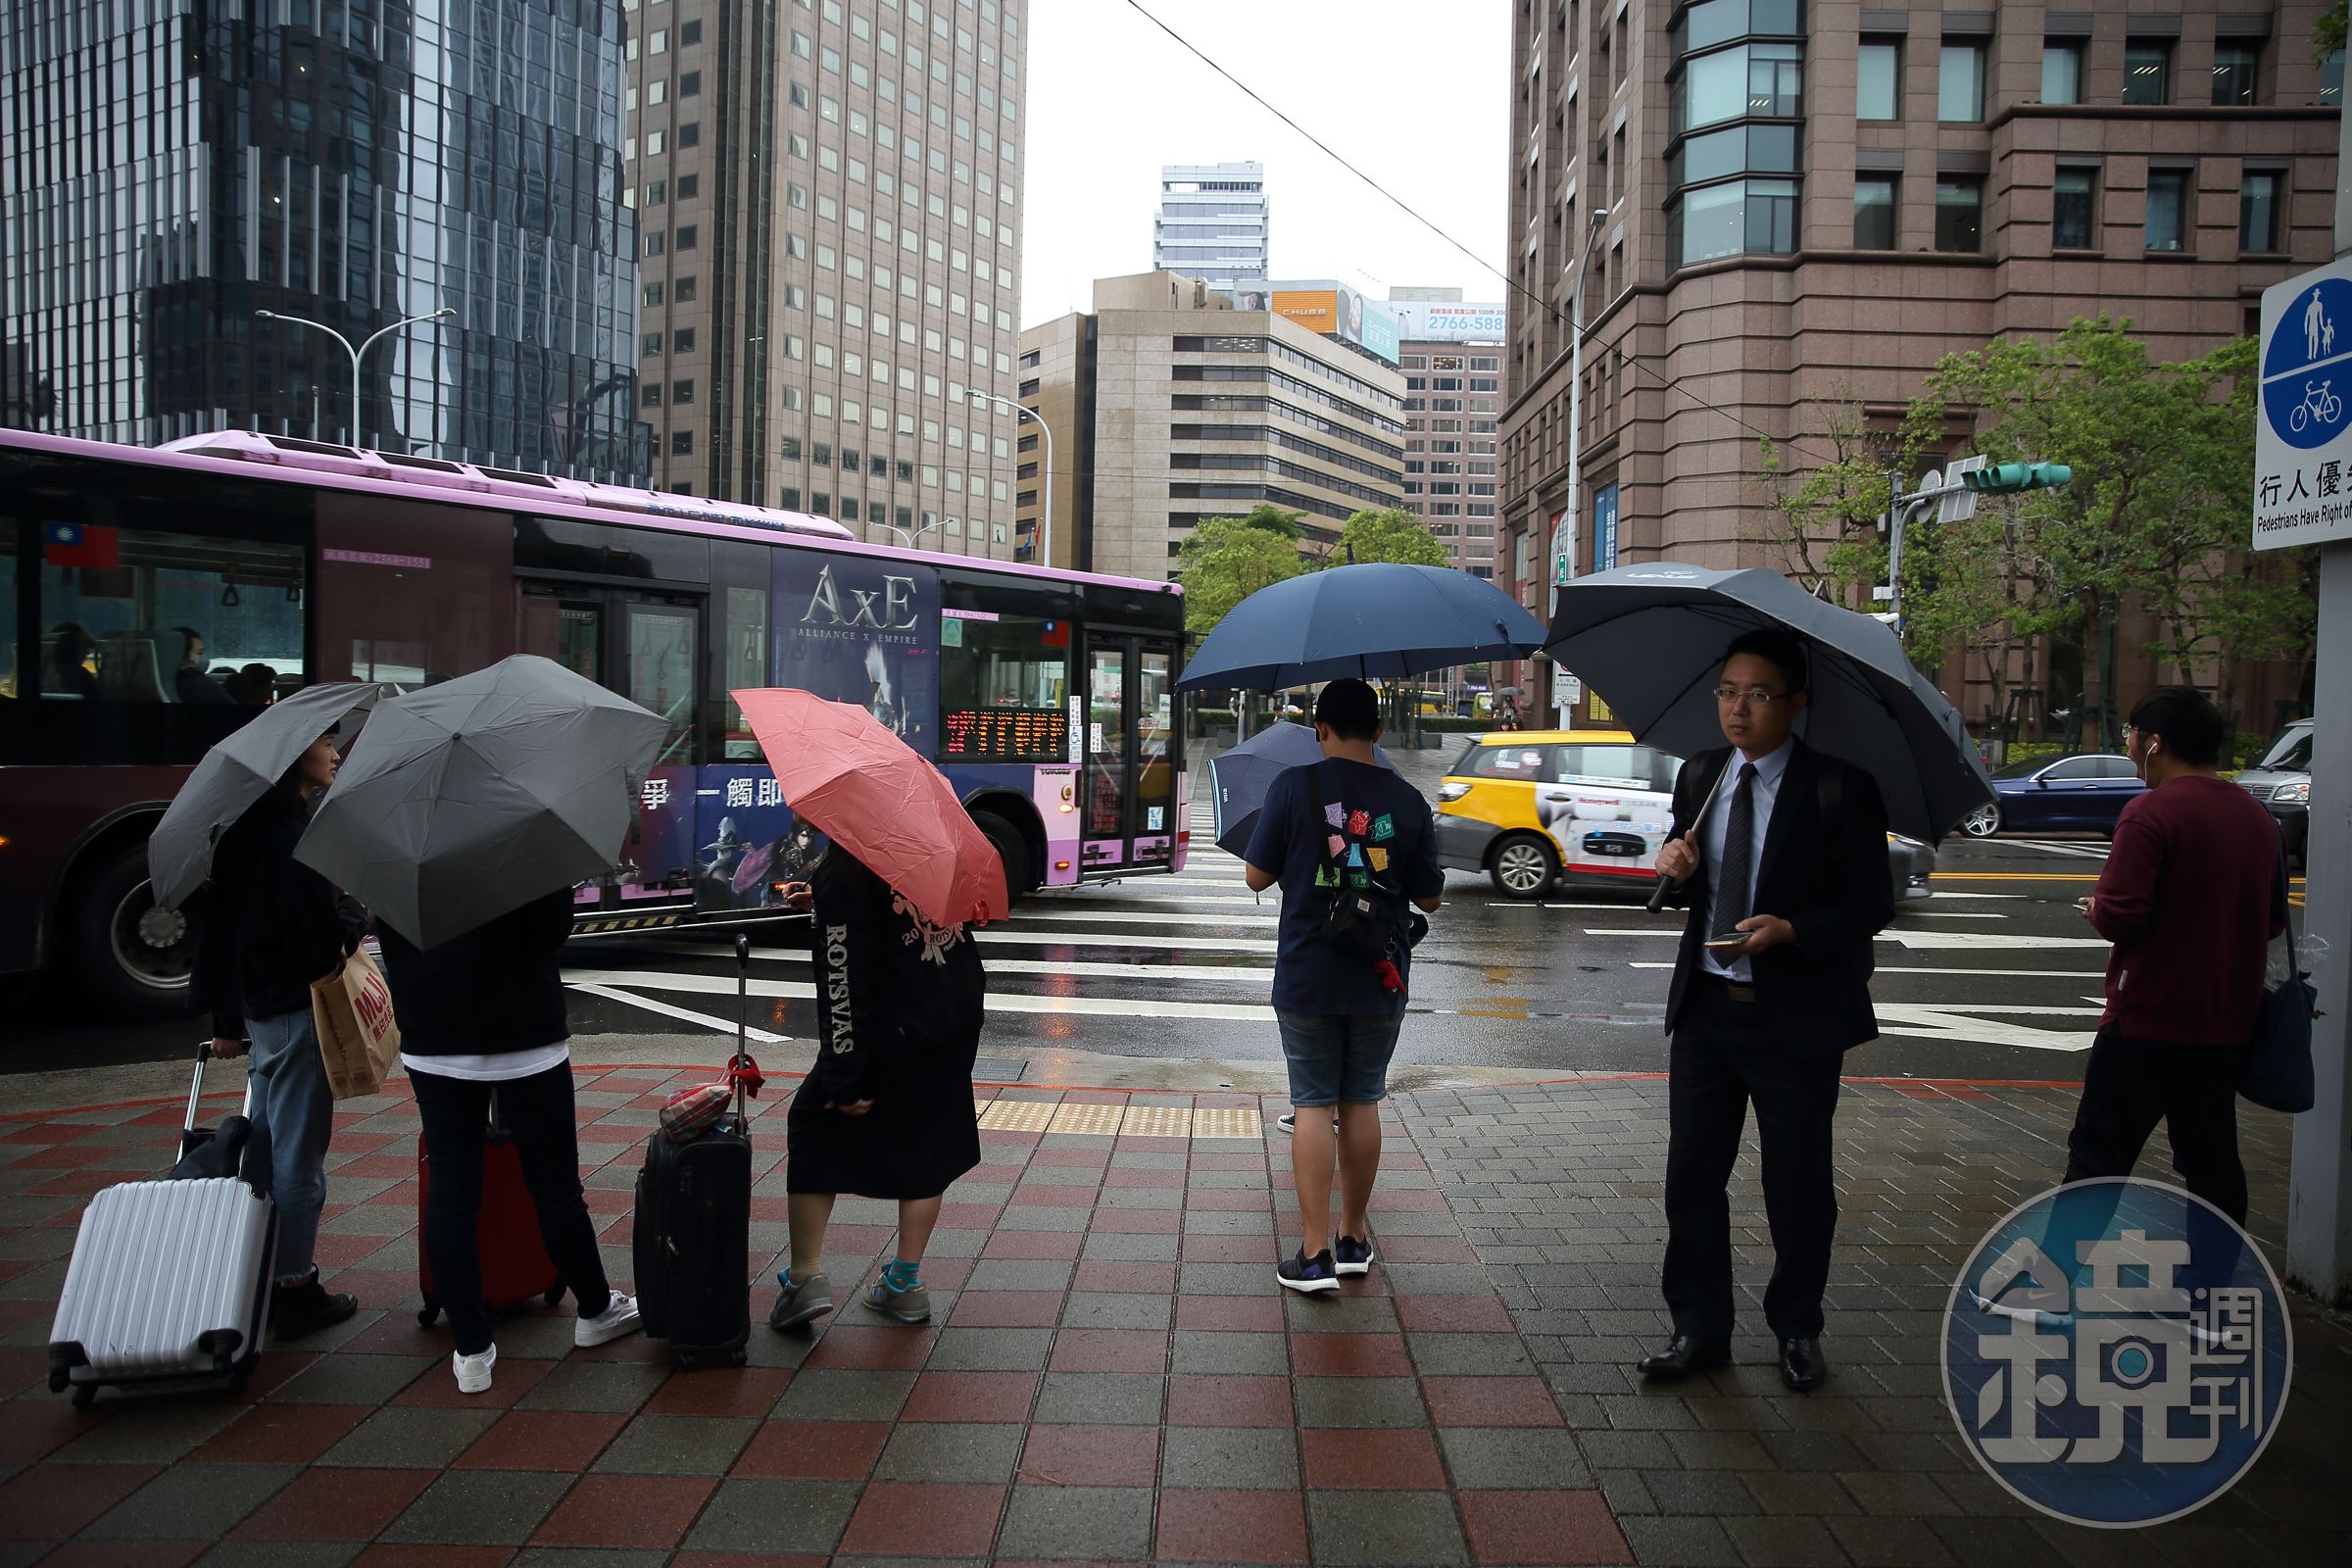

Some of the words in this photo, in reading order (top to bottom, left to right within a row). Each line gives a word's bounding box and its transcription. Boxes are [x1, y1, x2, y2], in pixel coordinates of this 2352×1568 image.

[1429, 316, 1506, 331] 2766-588
[2259, 460, 2352, 508] 行人優
[2257, 512, 2298, 533] Pedestrians
[2300, 508, 2320, 525] Have
[2321, 502, 2342, 527] Right
[798, 628, 856, 641] ALLIANCE
[862, 633, 870, 642] X
[877, 634, 918, 645] EMPIRE
[354, 971, 388, 1029] MUJI
[826, 923, 855, 1054] ROTSVAS
